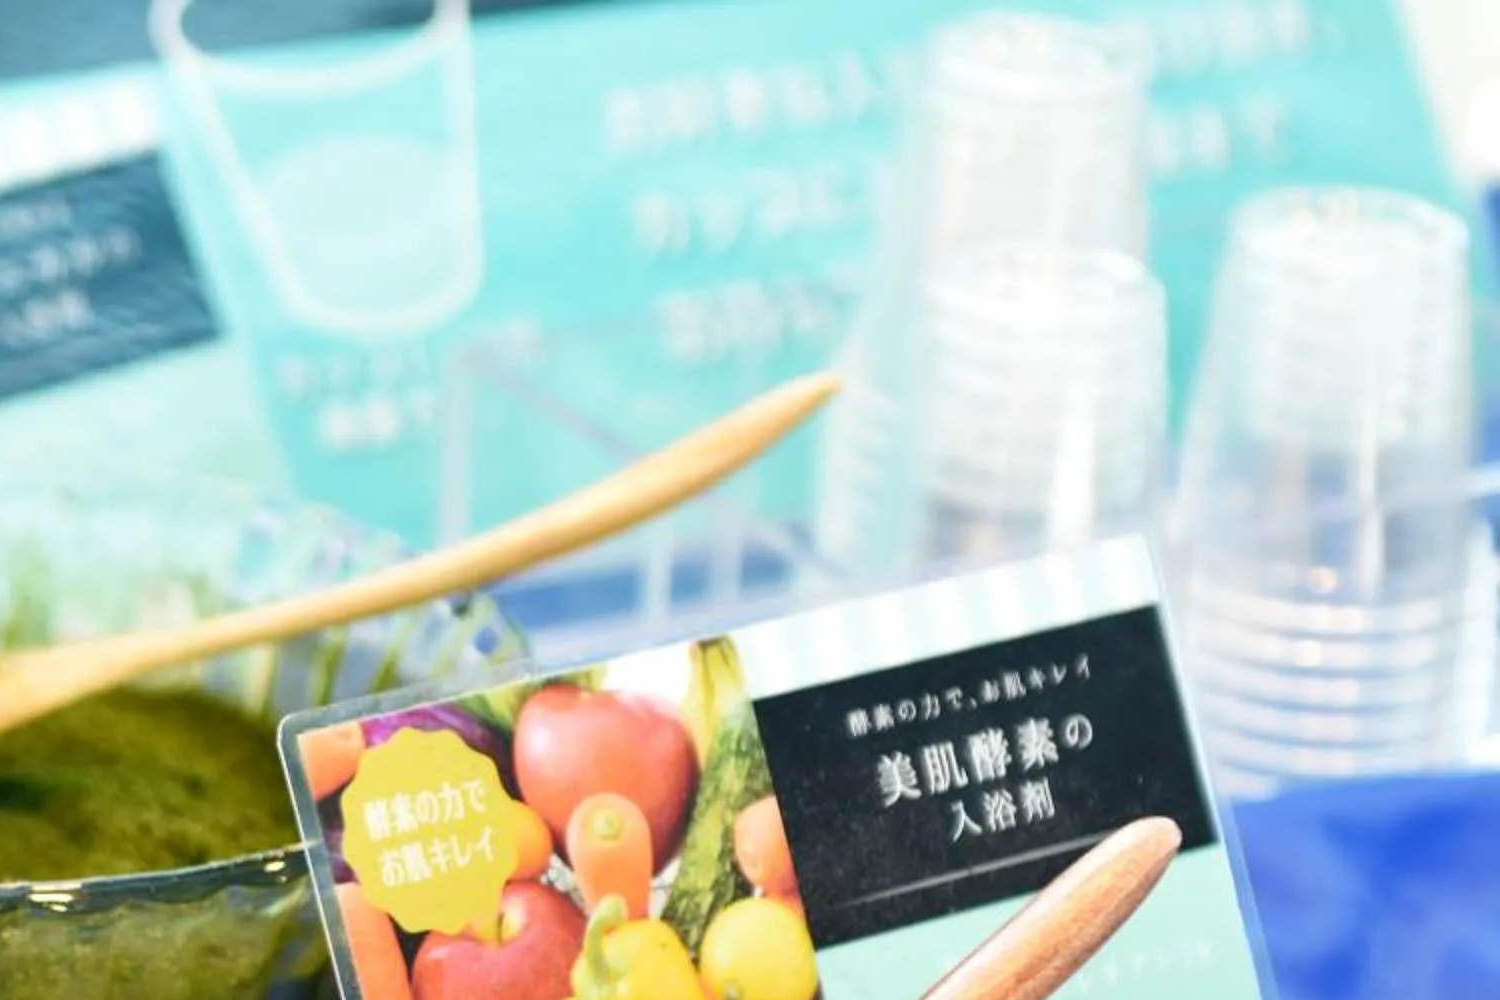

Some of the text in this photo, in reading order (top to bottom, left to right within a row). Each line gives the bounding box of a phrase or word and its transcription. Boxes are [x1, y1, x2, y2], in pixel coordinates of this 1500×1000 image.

[876, 713, 1094, 808] 美肌酵素の
[364, 779, 487, 842] 酵素の力で
[951, 776, 1055, 843] 入浴剤
[379, 825, 495, 888] お肌キレイ
